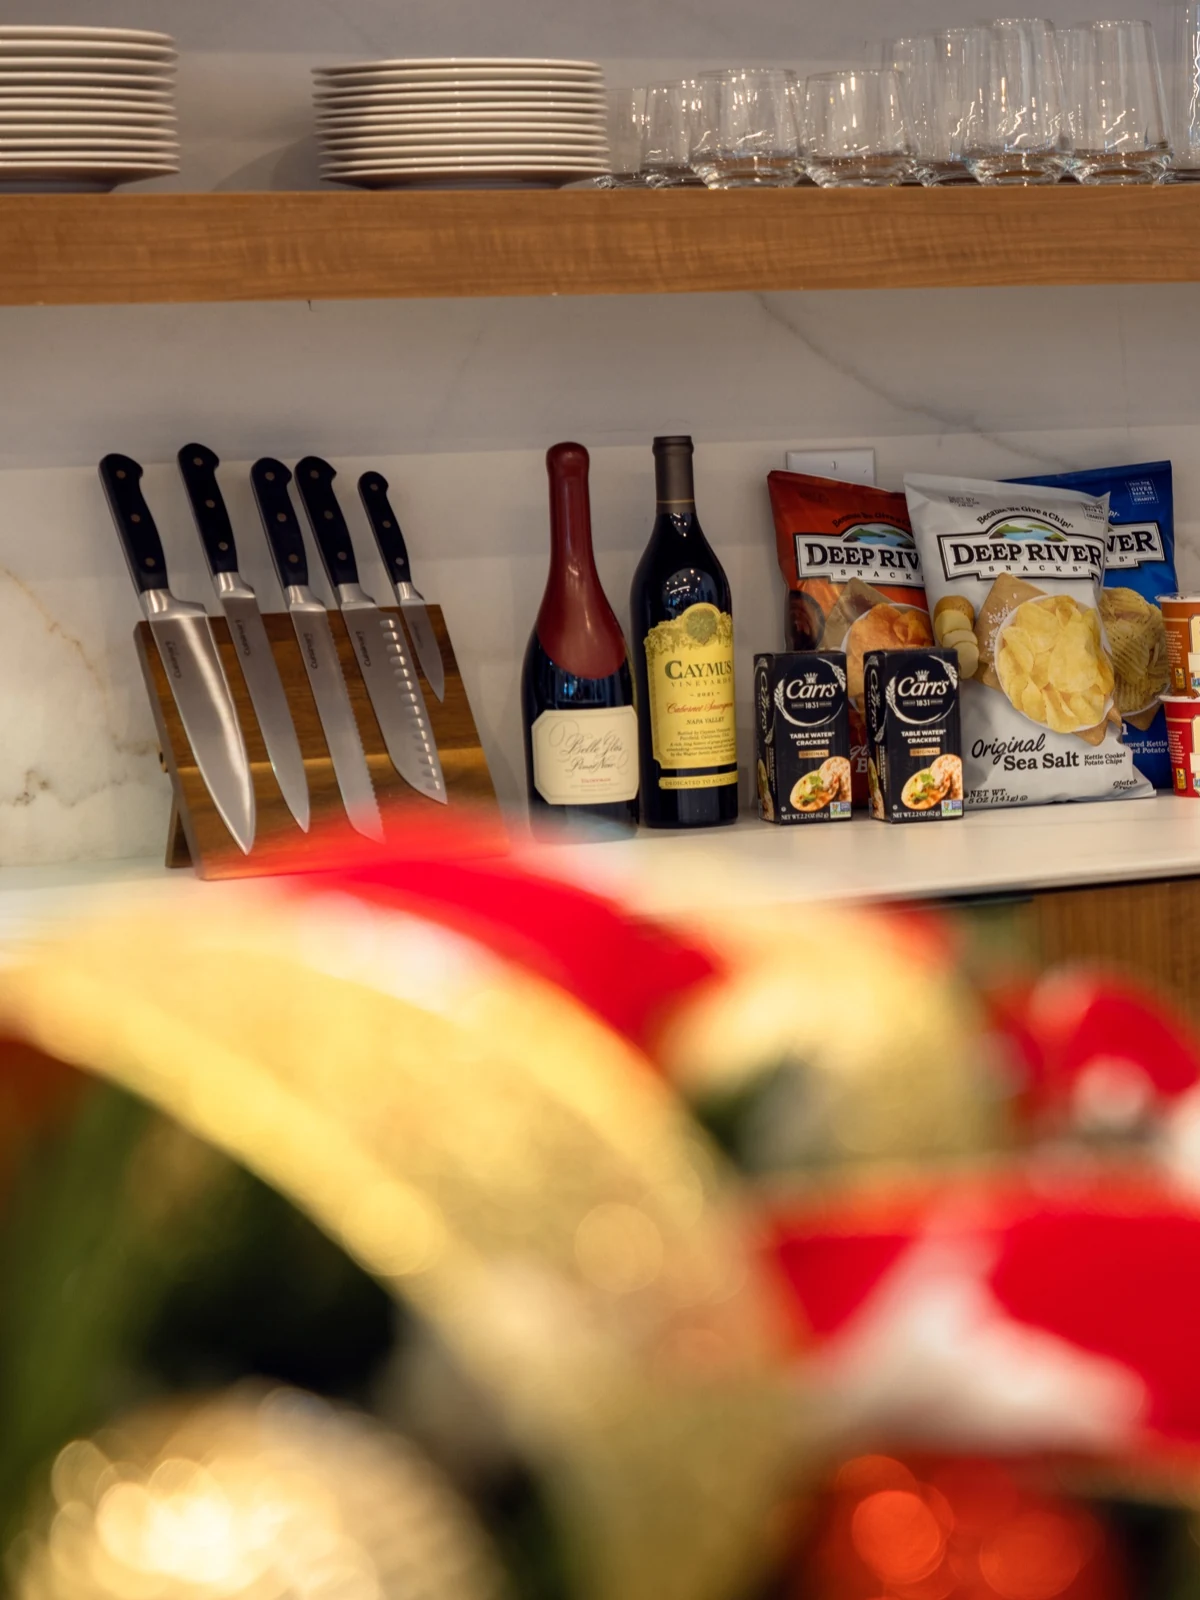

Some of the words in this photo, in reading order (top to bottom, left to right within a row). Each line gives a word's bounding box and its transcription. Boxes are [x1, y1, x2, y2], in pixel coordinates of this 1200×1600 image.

[1021, 505, 1041, 514] Give
[1106, 531, 1158, 552] VER
[804, 543, 875, 567] DEEP
[878, 549, 920, 570] RIV
[950, 543, 1022, 566] DEEP
[1027, 543, 1102, 569] RIVER
[664, 660, 732, 680] CAYMUS
[786, 680, 838, 700] Carr's
[898, 678, 950, 697] Carr's
[972, 733, 1046, 766] Original
[1105, 752, 1126, 760] Cooked
[1004, 754, 1038, 771] Sea
[1042, 751, 1080, 769] Salt
[991, 788, 1007, 798] WT.
